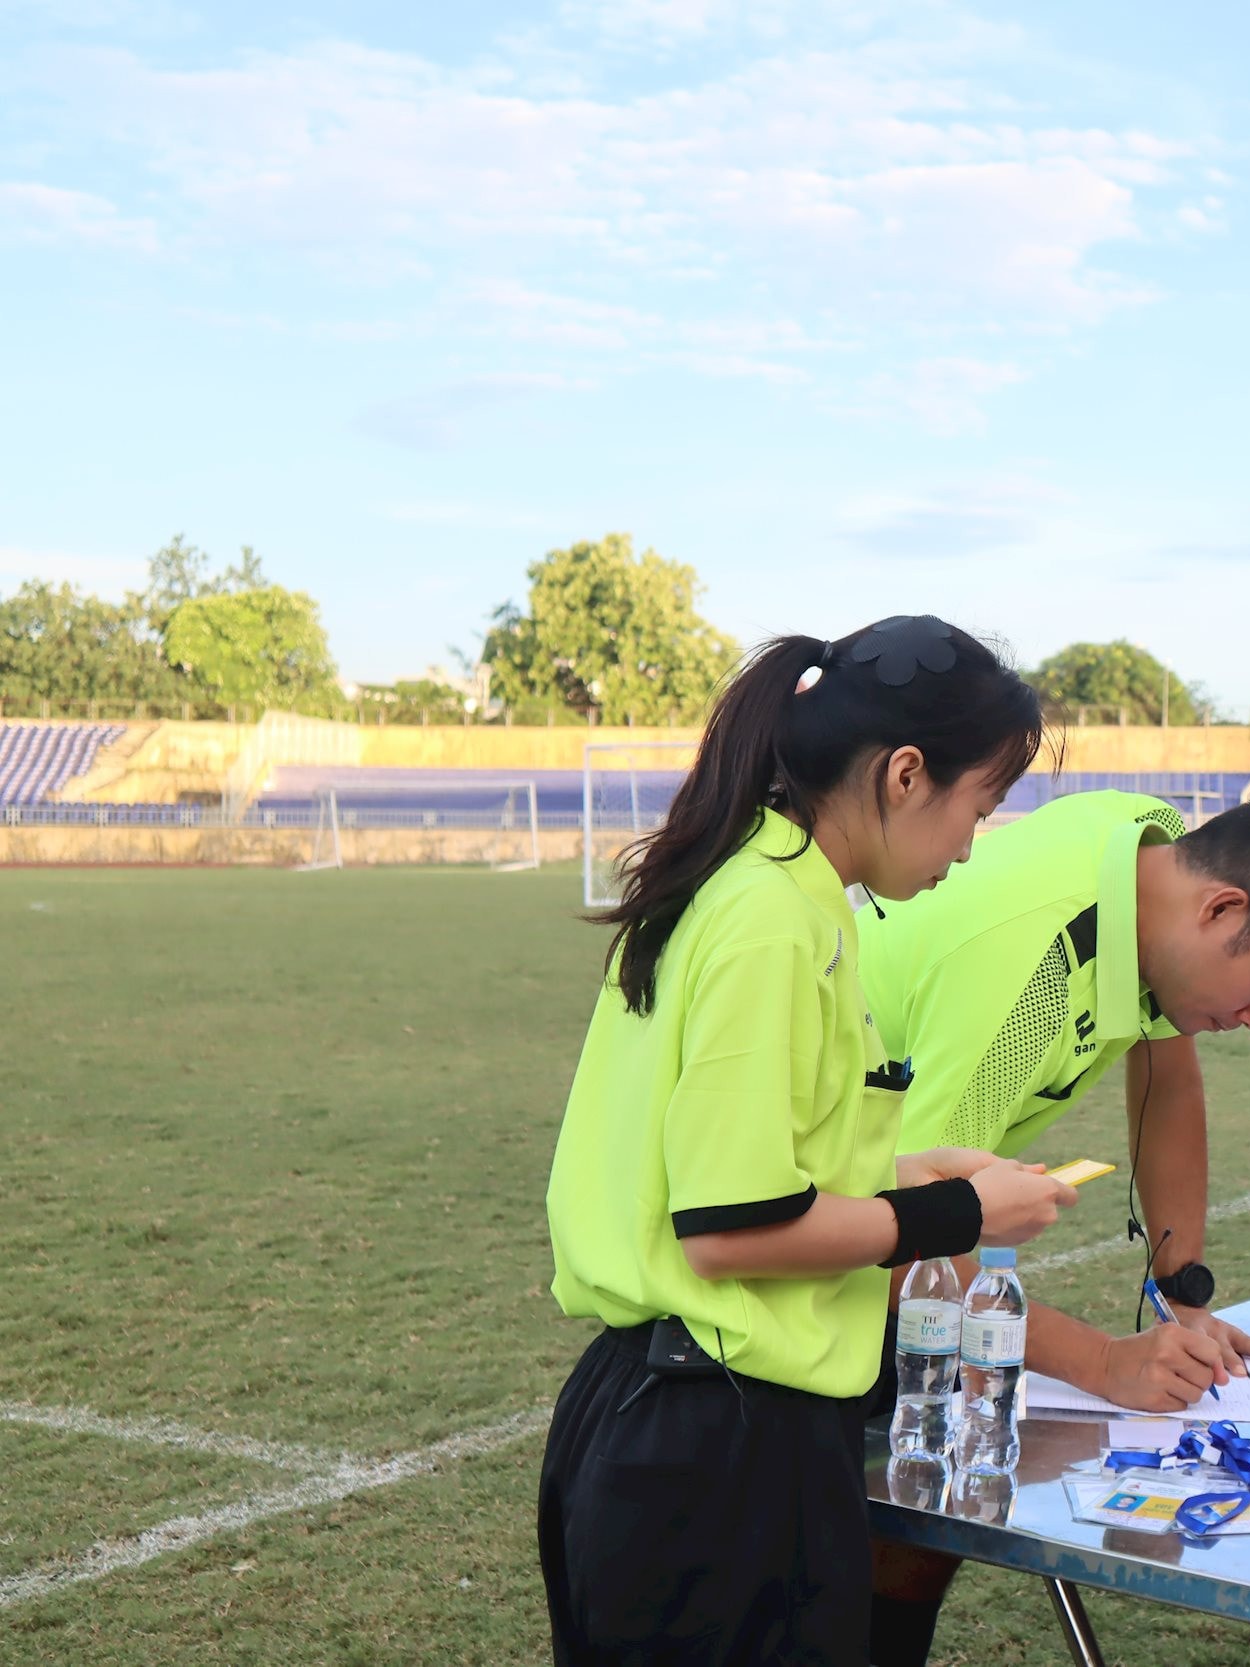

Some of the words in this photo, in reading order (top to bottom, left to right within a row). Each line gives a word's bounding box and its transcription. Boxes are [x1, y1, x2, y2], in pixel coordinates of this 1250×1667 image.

[1074, 1042, 1096, 1056] gan
[922, 1314, 937, 1324] TH
[921, 1324, 946, 1336] true
[920, 1336, 945, 1345] WATER
